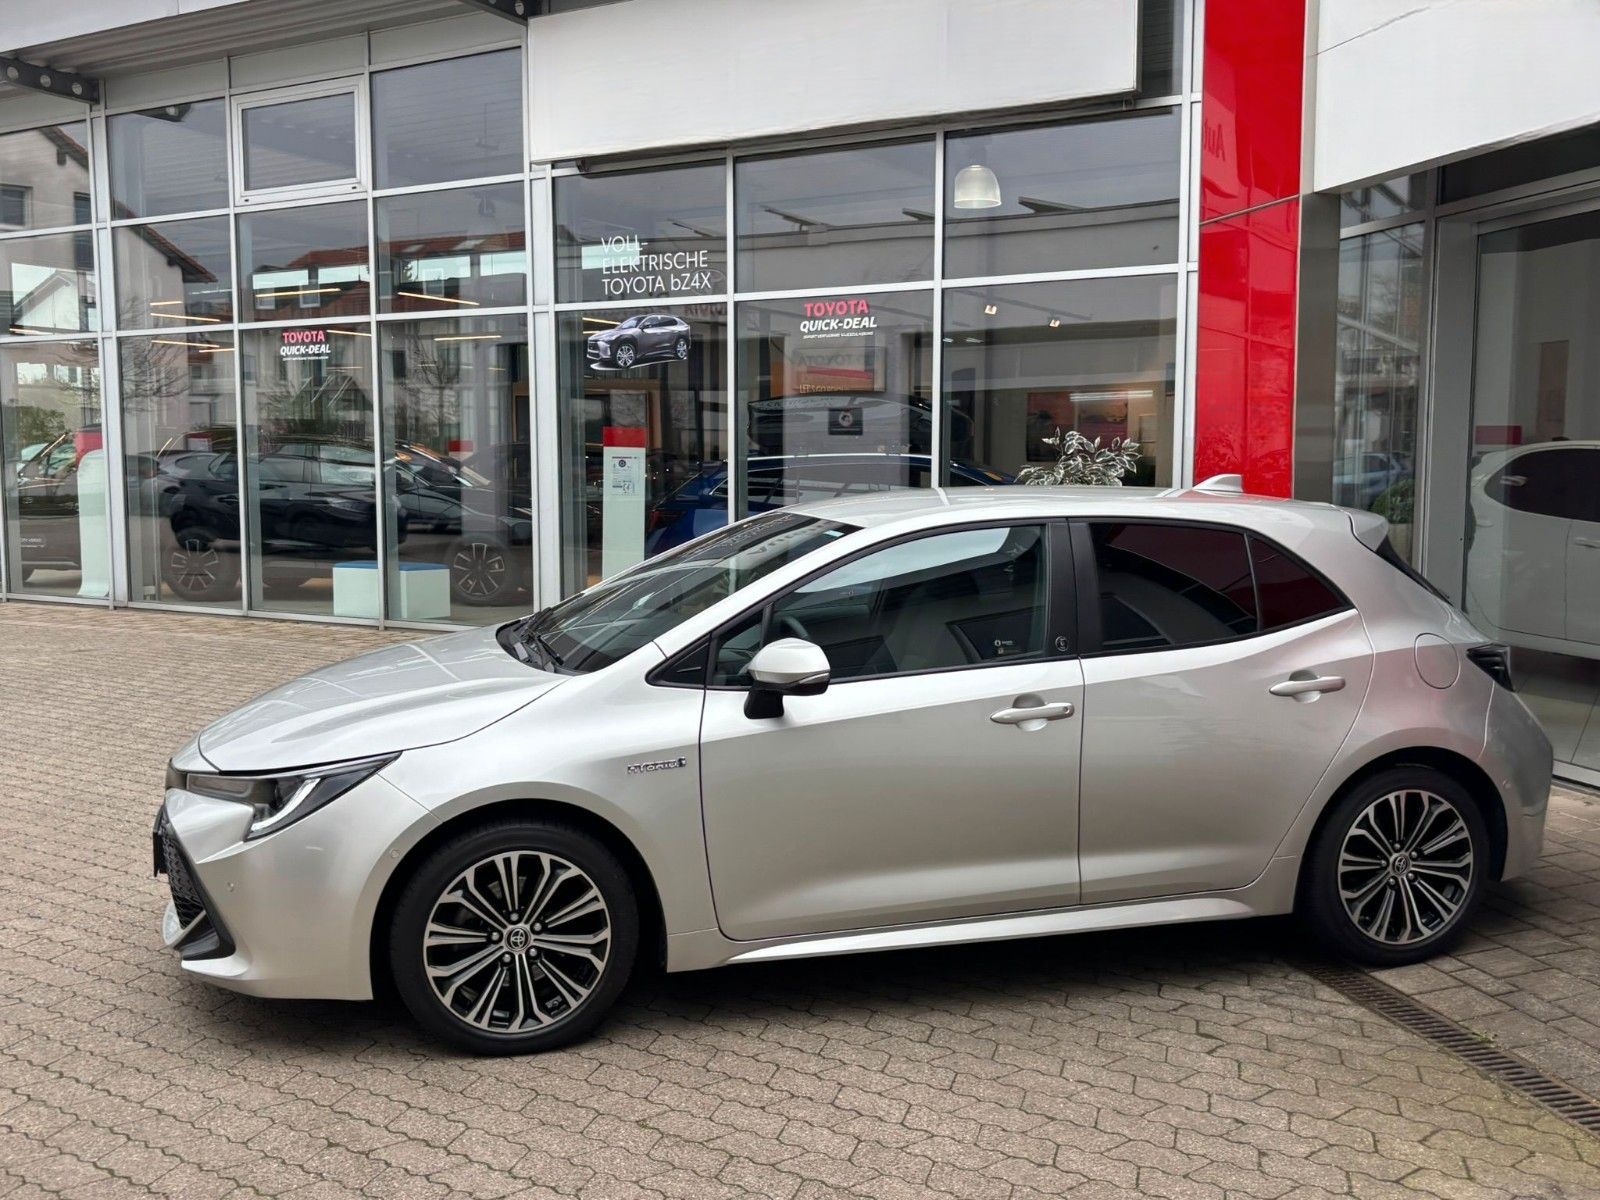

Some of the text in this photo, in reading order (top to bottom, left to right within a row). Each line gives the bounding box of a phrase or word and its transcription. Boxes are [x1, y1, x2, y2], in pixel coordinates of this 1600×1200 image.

[601, 234, 648, 254] VOLL-
[602, 250, 708, 275] ELEKTRISCHE
[602, 272, 711, 295] TOYOTA bZ4X
[804, 300, 869, 317] TOYOTA
[800, 316, 878, 333] QUICK-DEAL
[282, 330, 325, 343] TOYOTA
[280, 344, 331, 356] QUICK-DEAL
